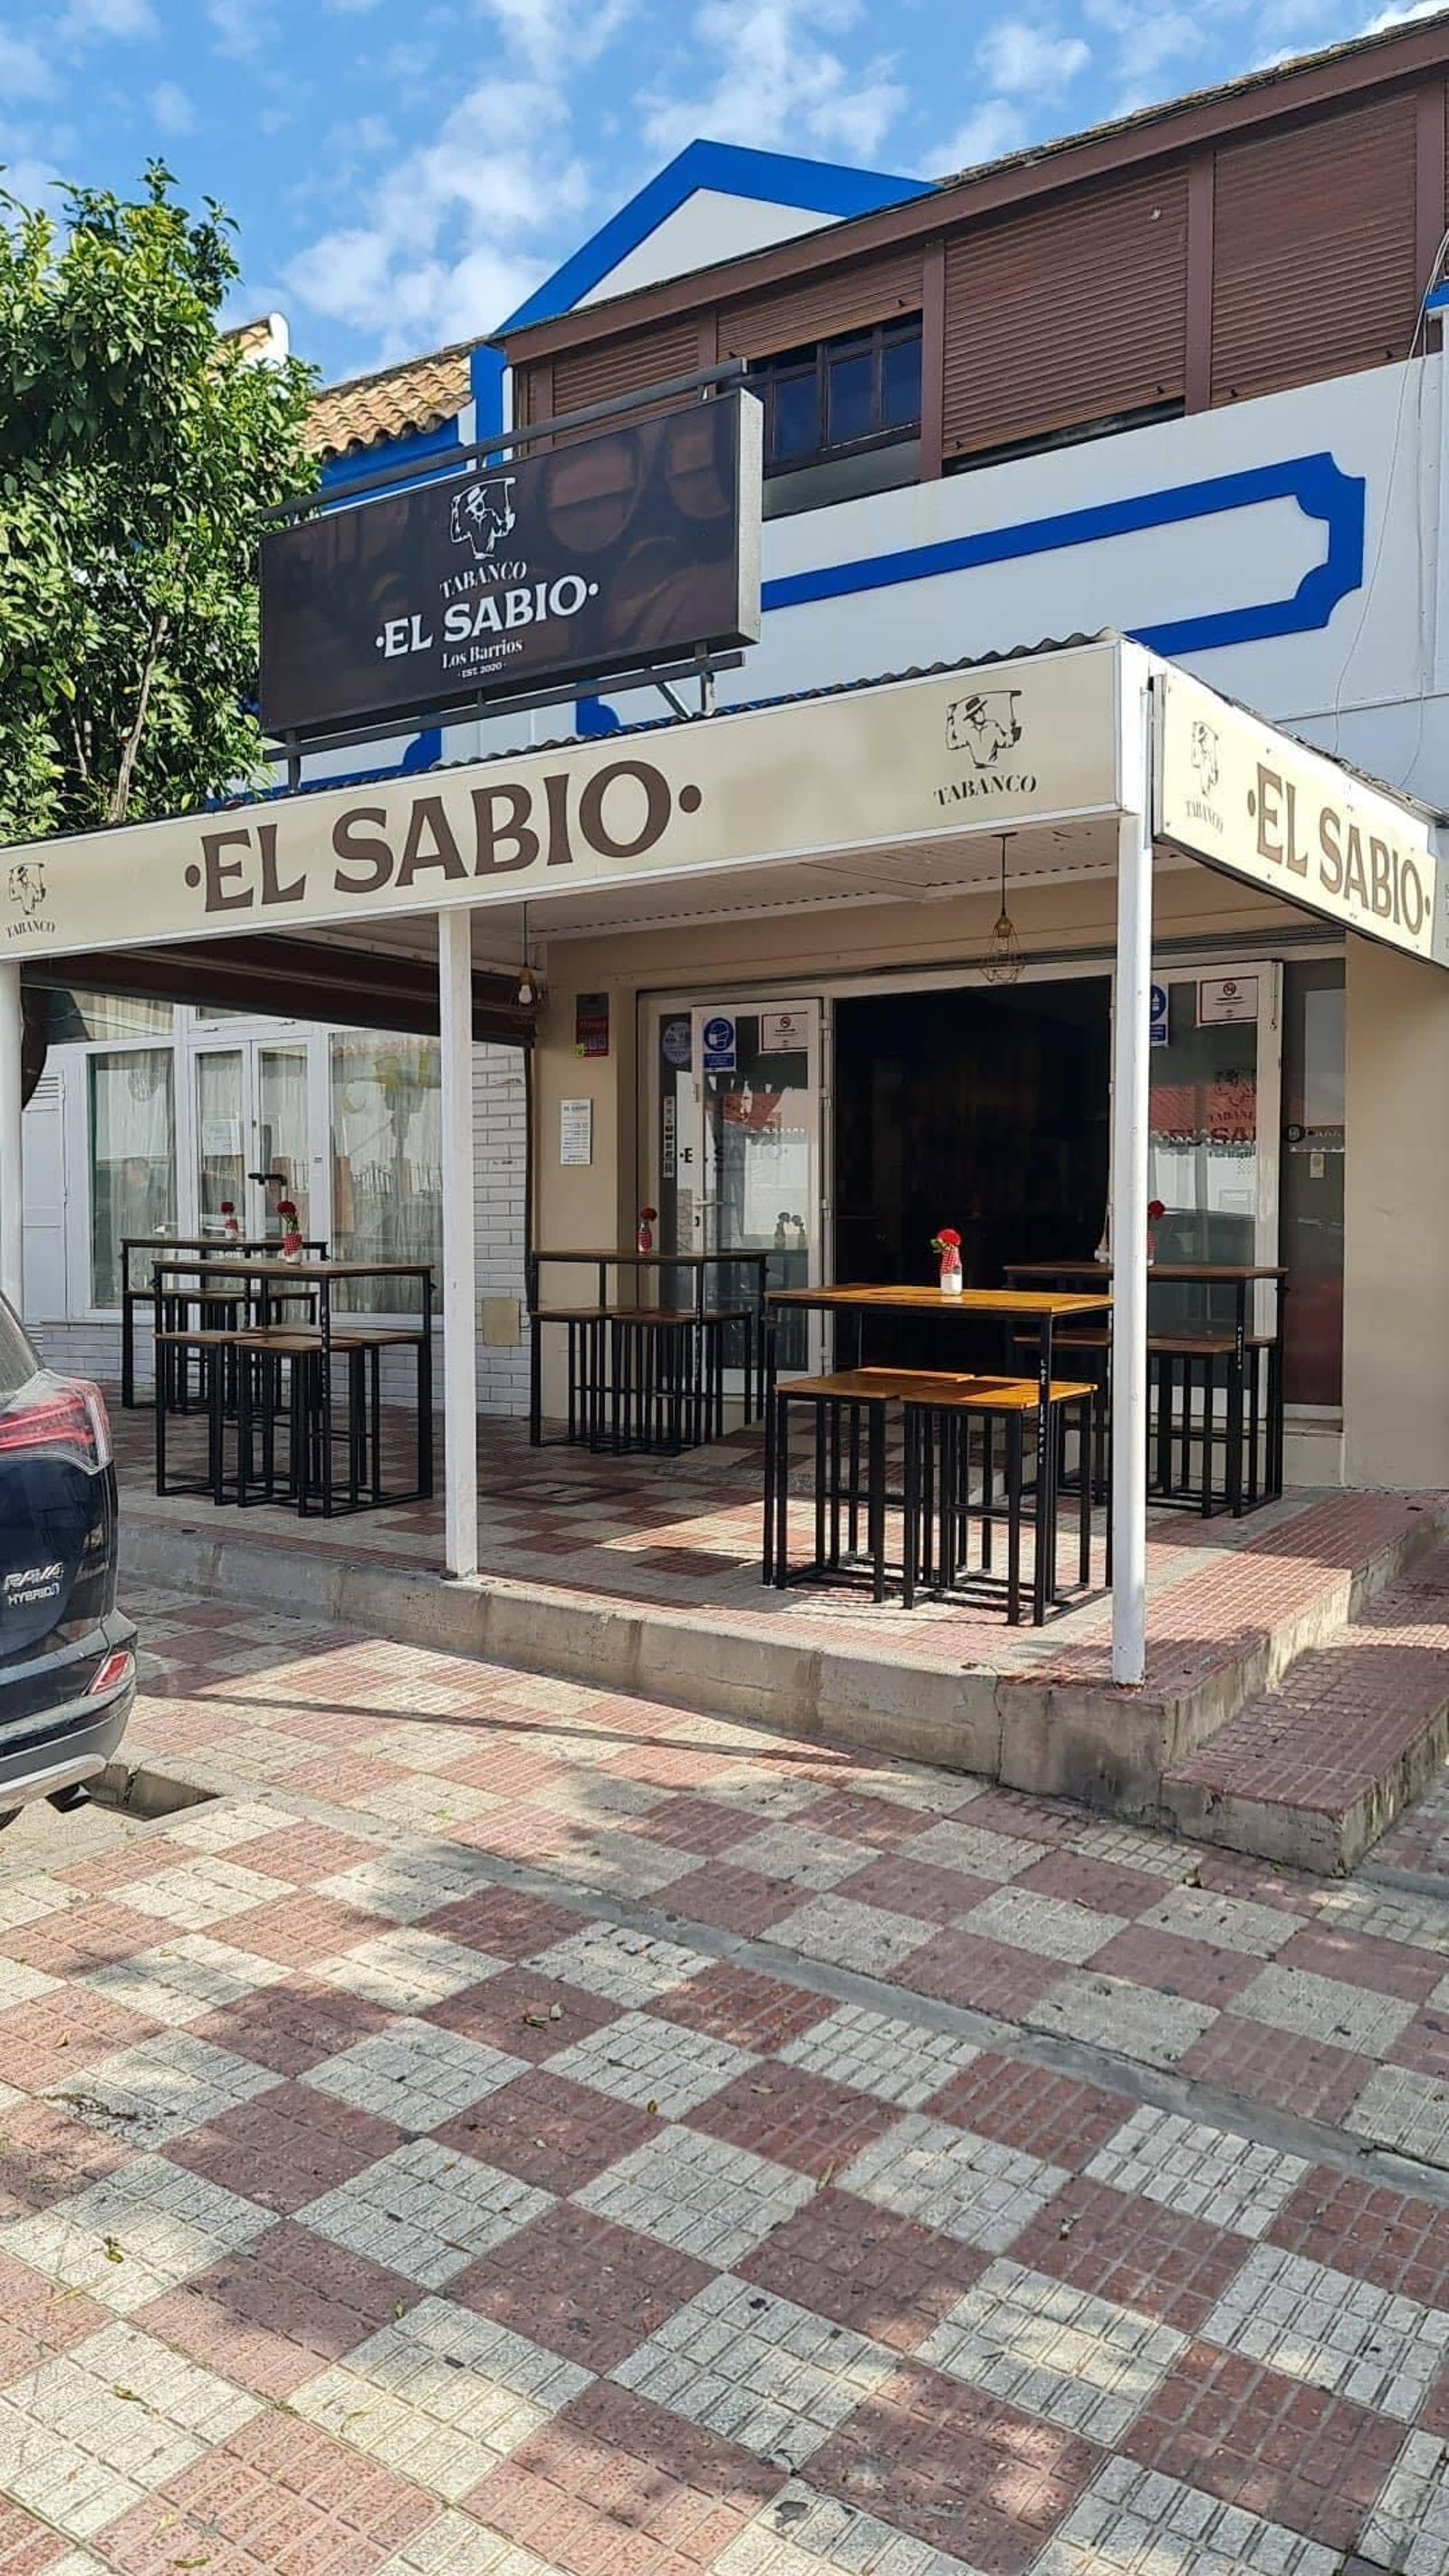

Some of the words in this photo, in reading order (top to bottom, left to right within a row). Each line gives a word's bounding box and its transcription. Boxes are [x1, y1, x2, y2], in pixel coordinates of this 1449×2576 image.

[439, 561, 527, 600] TABANCO
[441, 652, 466, 668] Los
[470, 638, 523, 664] Barrios
[933, 774, 1037, 806] TABANCO
[1184, 800, 1223, 834] TABANCO
[5, 920, 55, 938] TABANCO
[3, 1562, 63, 1590] RAV4
[7, 1586, 53, 1606] HYBRID
